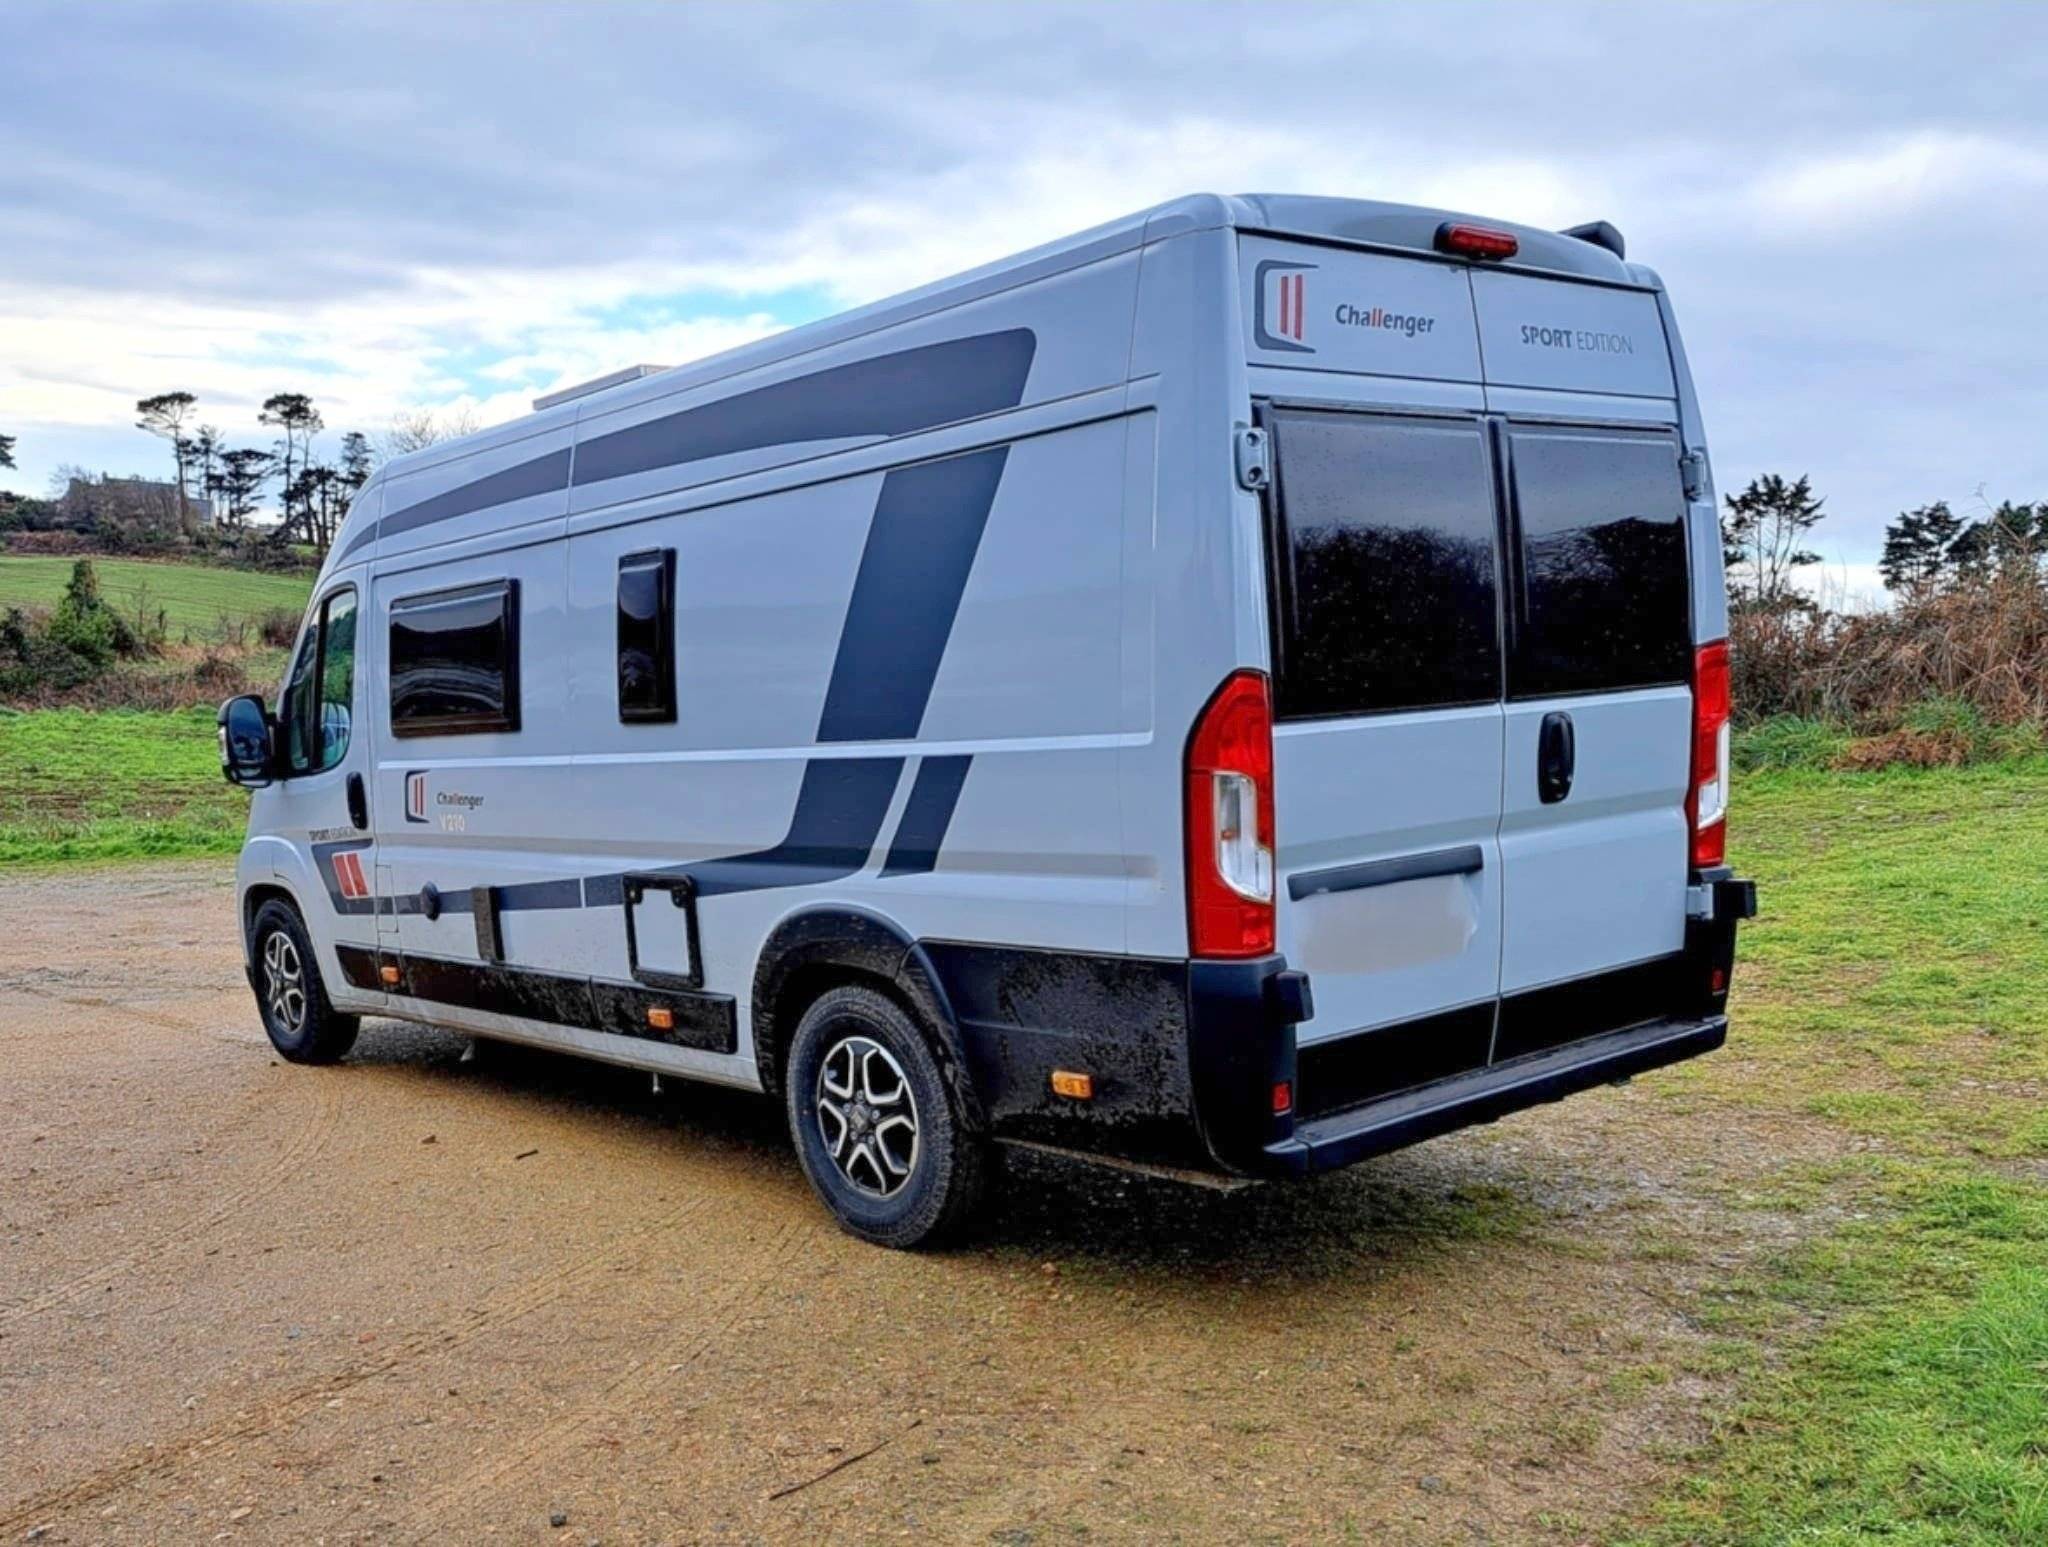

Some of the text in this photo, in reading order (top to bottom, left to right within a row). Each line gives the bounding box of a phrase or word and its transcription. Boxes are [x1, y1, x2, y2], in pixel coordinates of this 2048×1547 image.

[1335, 303, 1435, 338] Challenger
[1521, 325, 1633, 354] SPORT EDITION
[436, 791, 484, 810] Challenger
